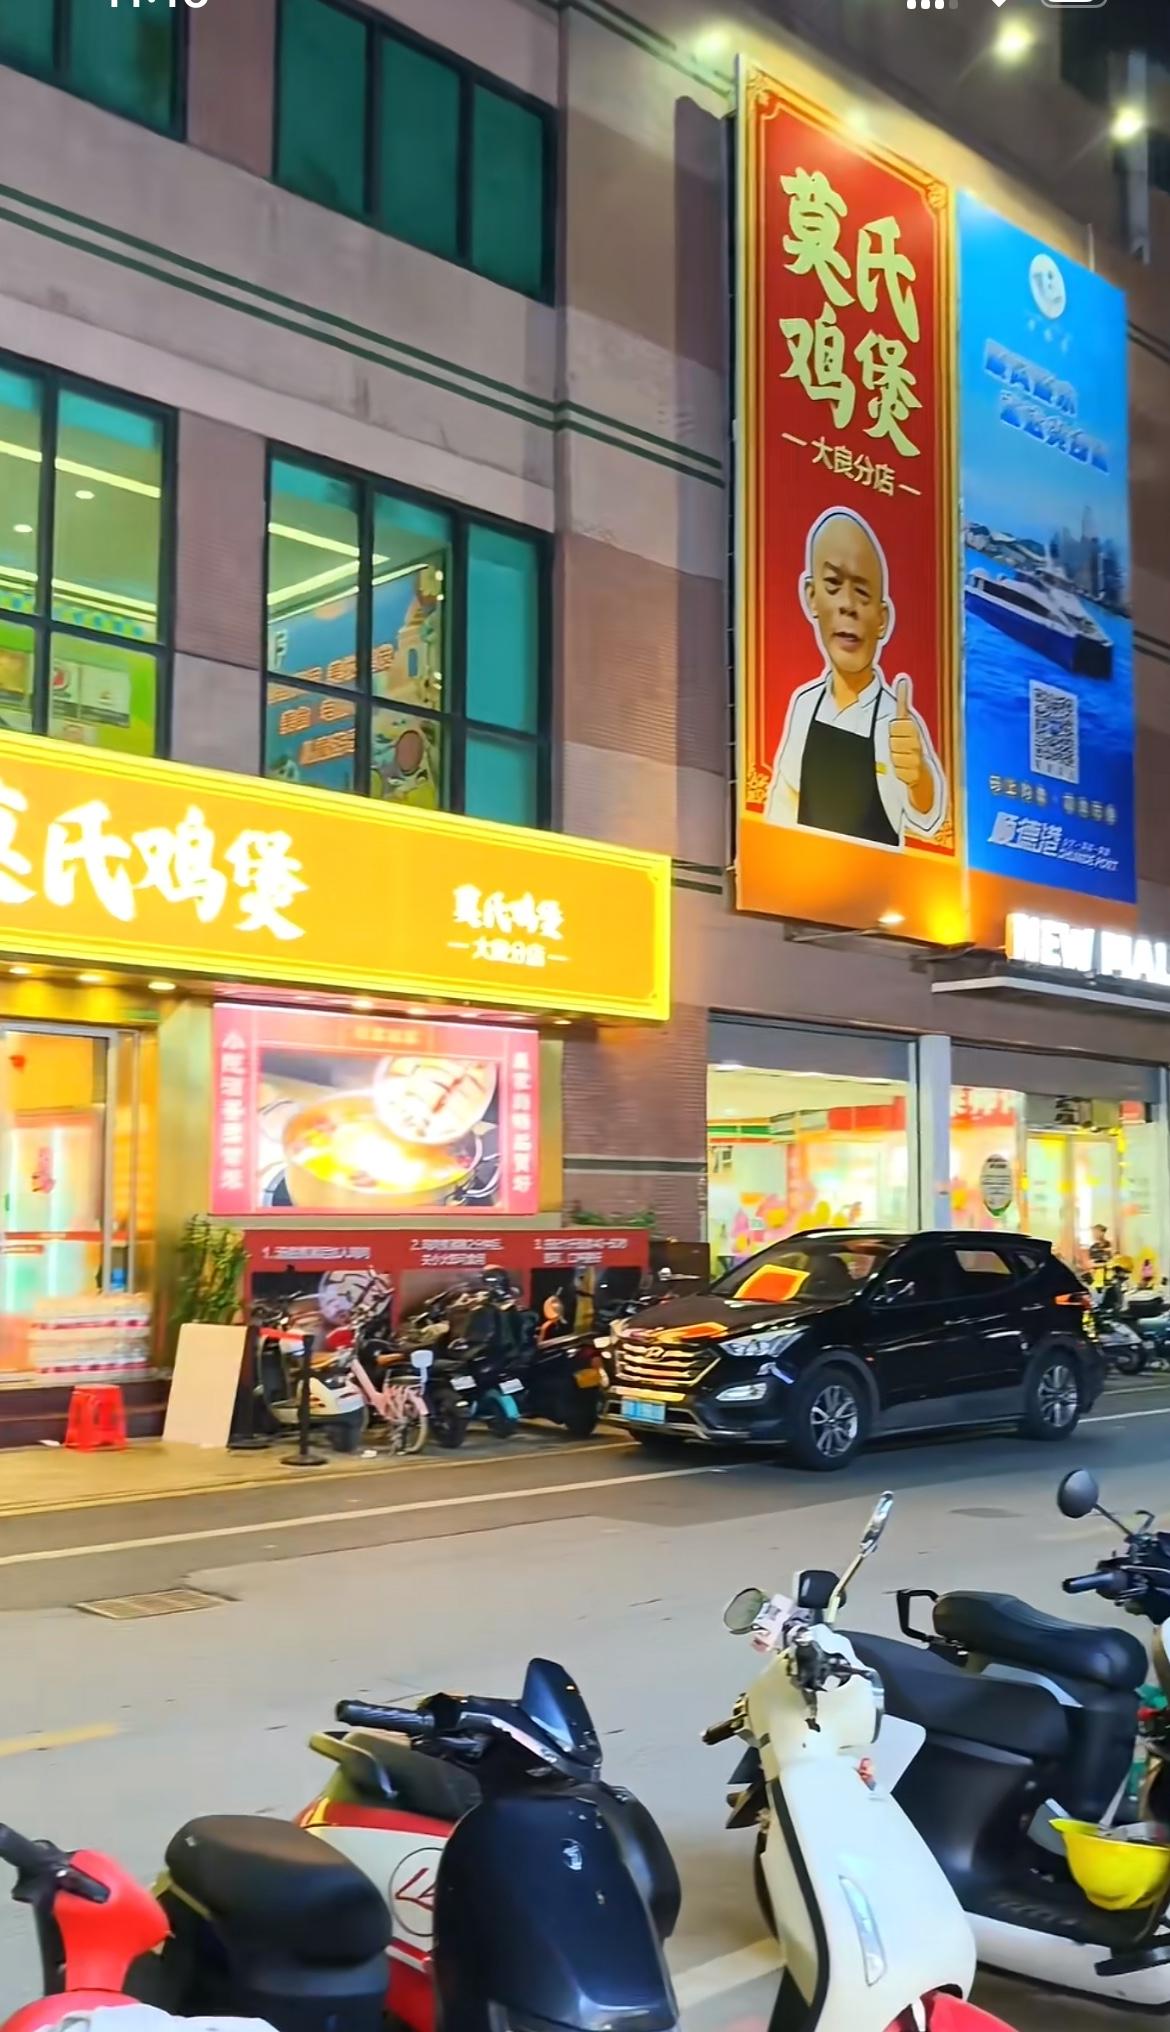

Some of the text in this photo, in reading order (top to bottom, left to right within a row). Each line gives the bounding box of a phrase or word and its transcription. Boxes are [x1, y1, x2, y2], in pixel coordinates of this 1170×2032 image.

[811, 436, 897, 496] 大良分店
[453, 884, 565, 940] 莫氏鸡煲
[1006, 913, 1095, 971] NEW
